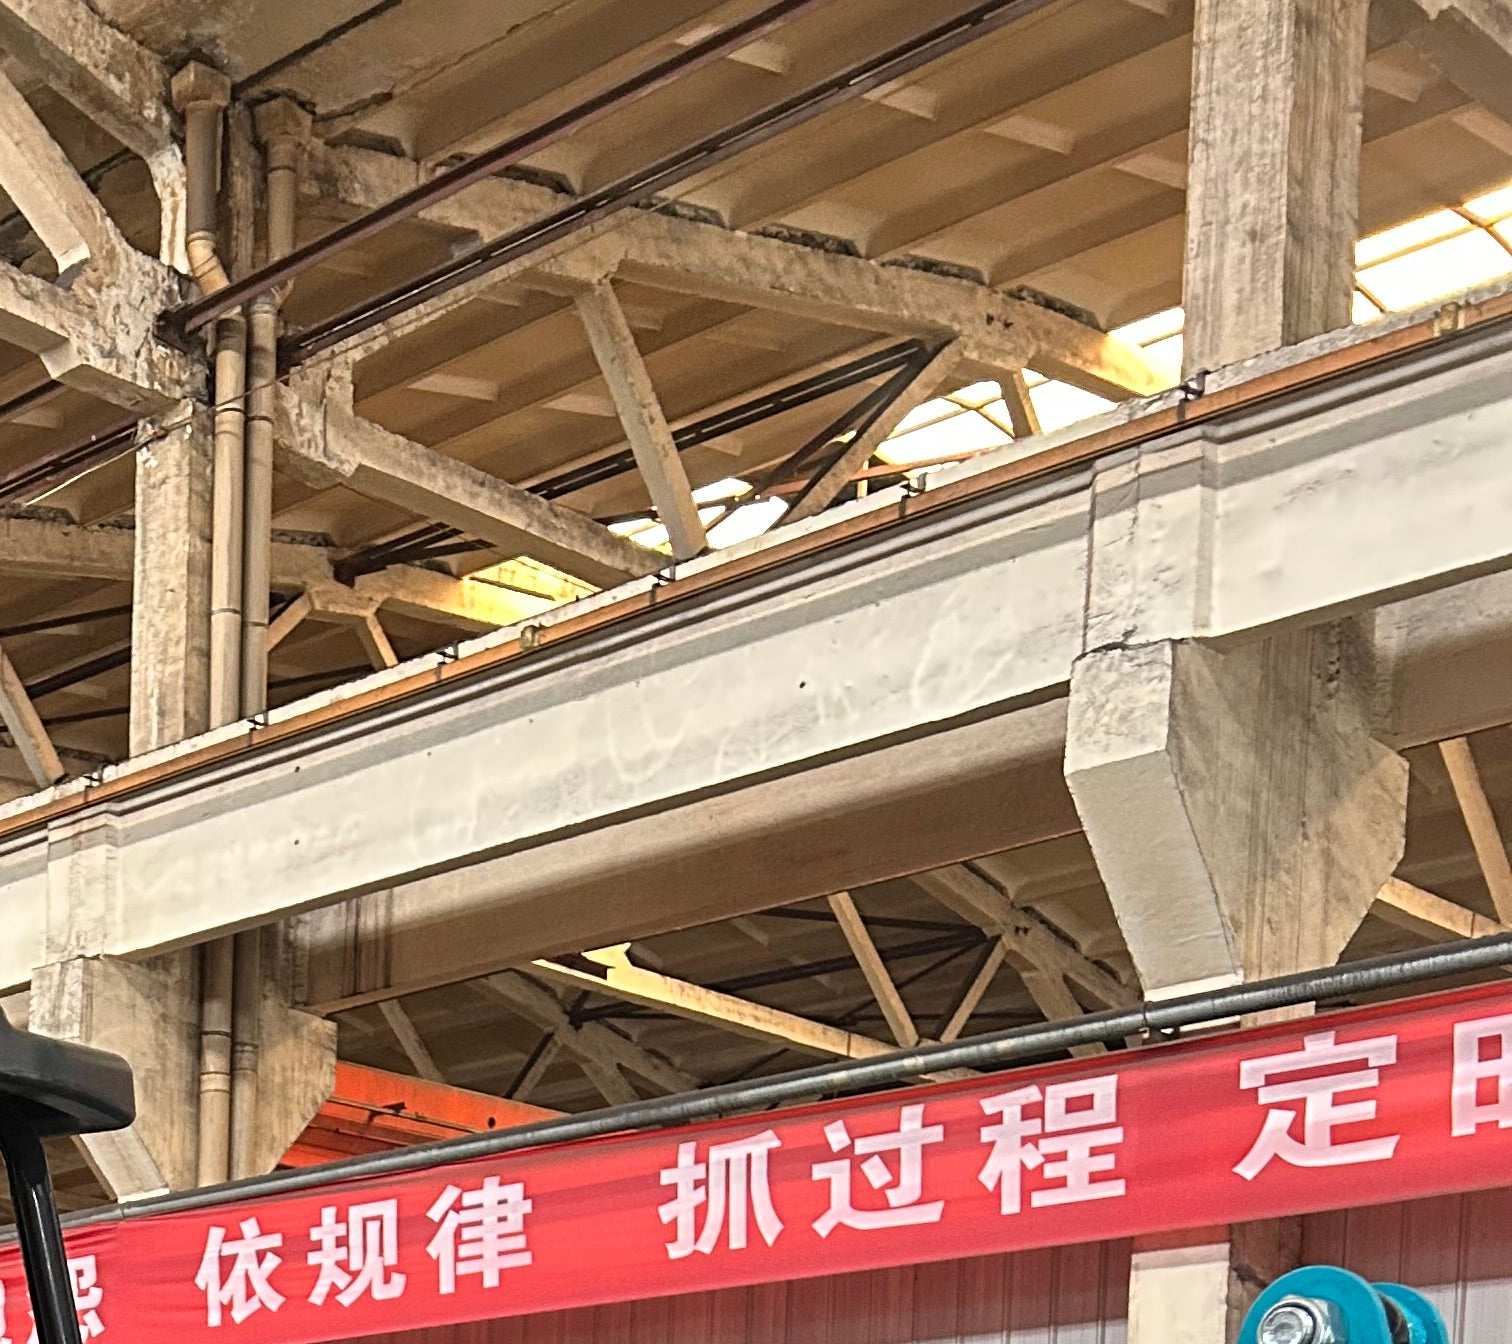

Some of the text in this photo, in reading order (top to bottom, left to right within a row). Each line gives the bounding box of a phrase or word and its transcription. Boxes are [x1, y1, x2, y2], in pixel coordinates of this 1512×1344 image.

[194, 1176, 534, 1328] 依规律
[657, 1074, 1127, 1260] 抓过程
